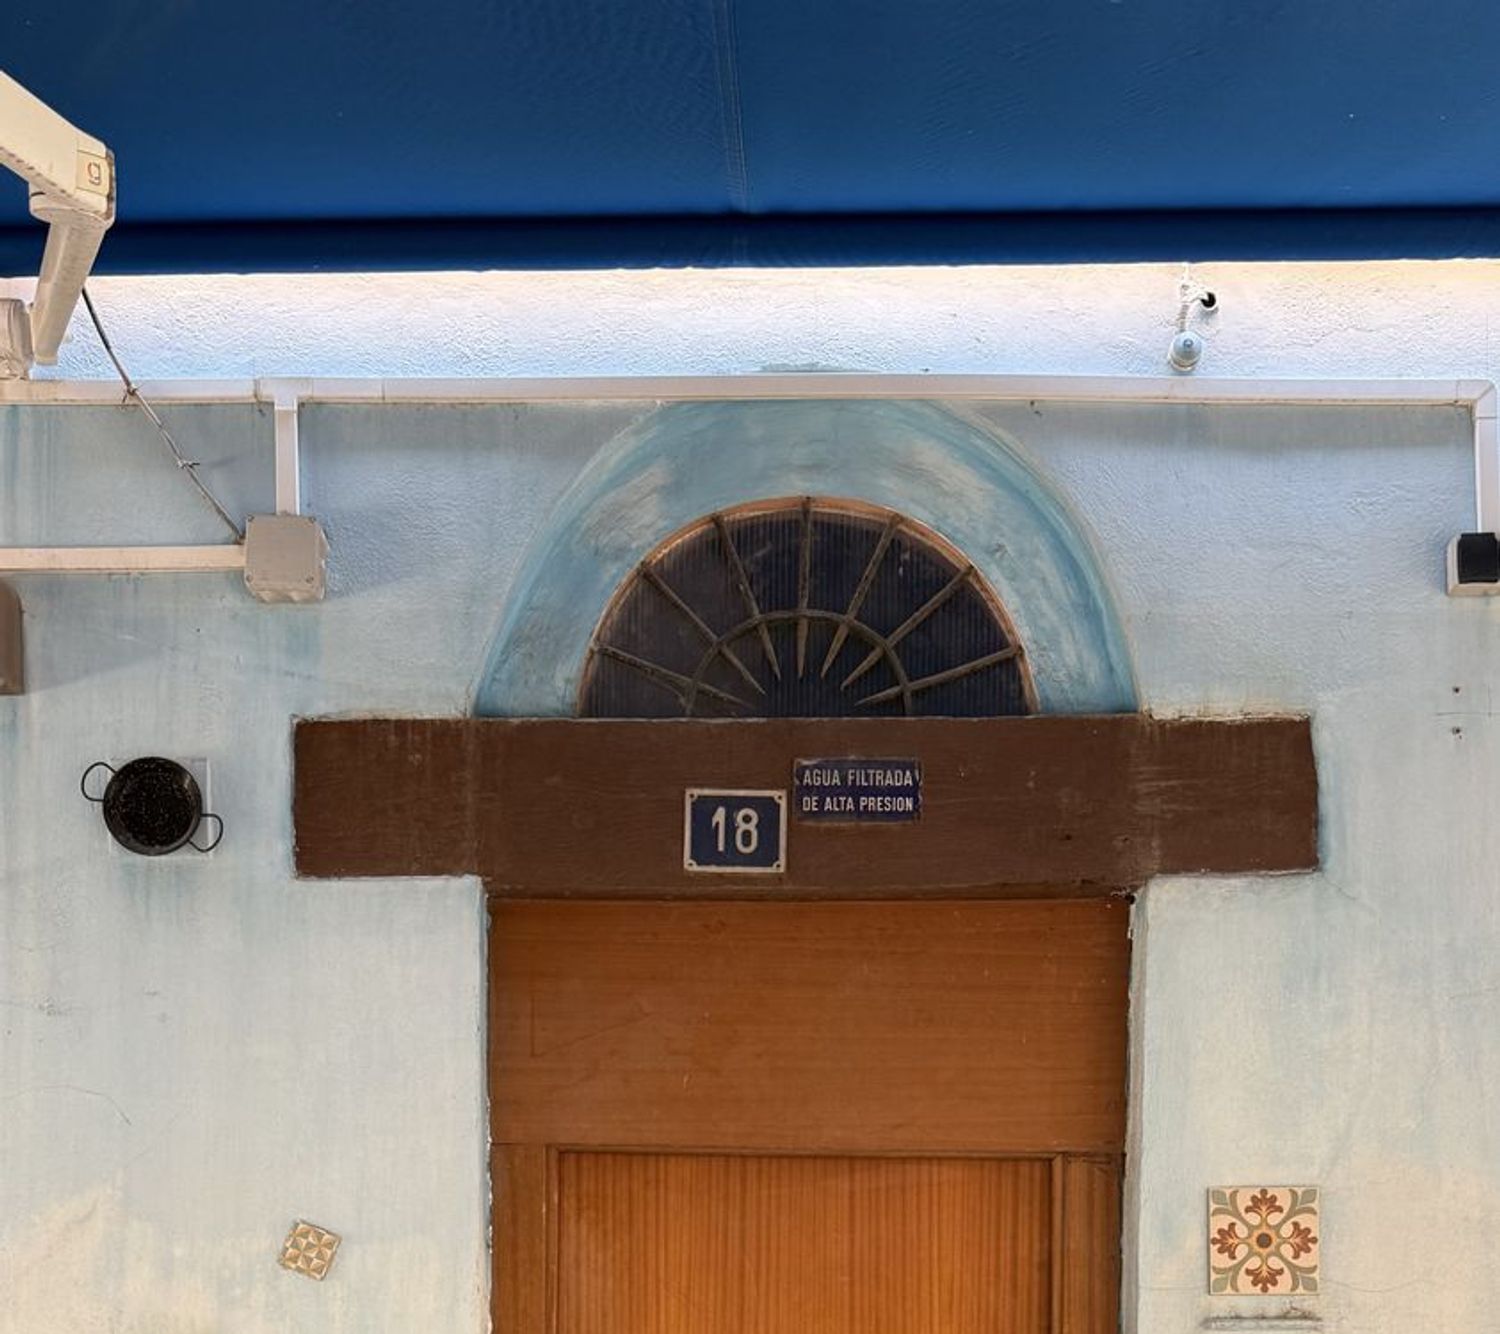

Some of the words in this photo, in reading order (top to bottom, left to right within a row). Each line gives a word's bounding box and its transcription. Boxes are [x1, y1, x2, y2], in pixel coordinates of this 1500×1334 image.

[802, 769, 841, 787] AGUA
[848, 769, 914, 787] FILTRADA
[802, 797, 819, 812] DE
[823, 797, 855, 812] ALTA
[859, 797, 914, 812] PRESION
[711, 806, 759, 854] 18
